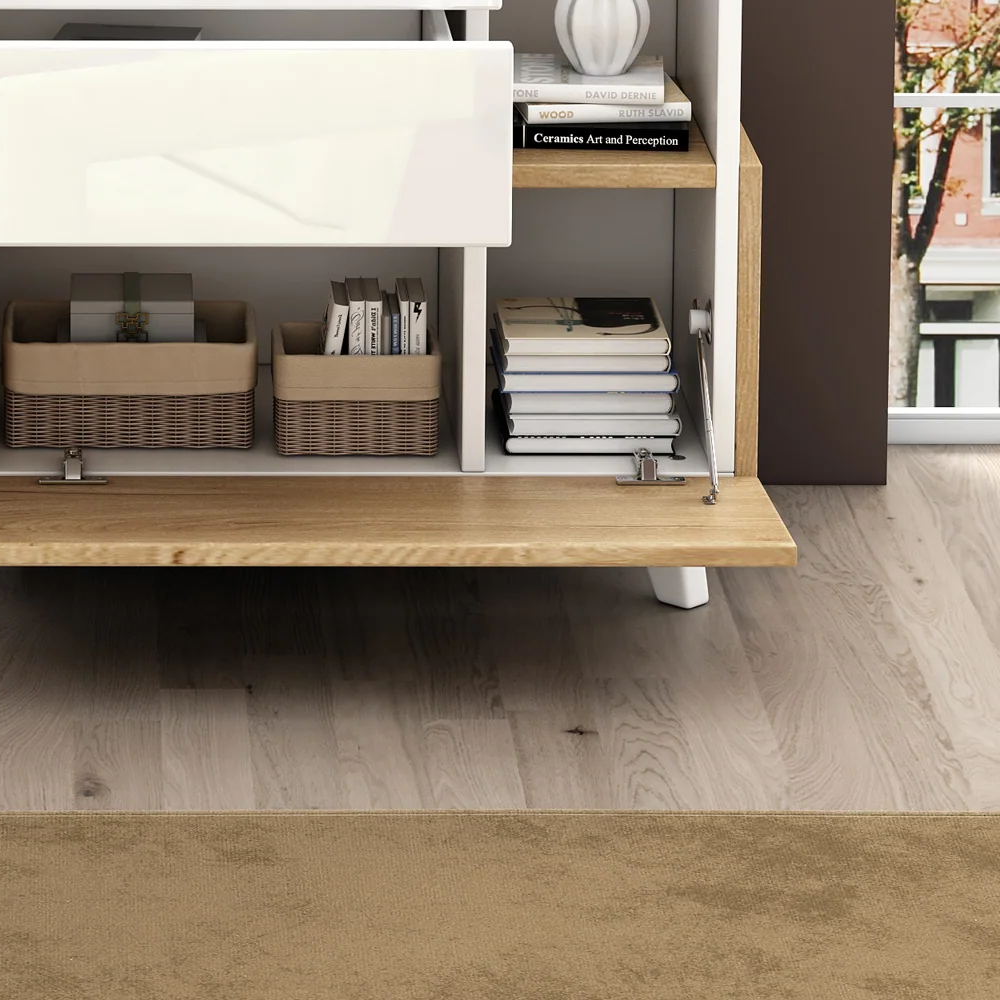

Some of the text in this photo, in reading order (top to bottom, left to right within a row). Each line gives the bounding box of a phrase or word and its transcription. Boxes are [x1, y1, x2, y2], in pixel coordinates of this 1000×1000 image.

[585, 91, 617, 99] DAVID
[621, 91, 657, 100] DERNIE
[539, 108, 684, 119] WOOD RUTH SLAVID
[534, 133, 679, 147] Ceramics Art and Perception
